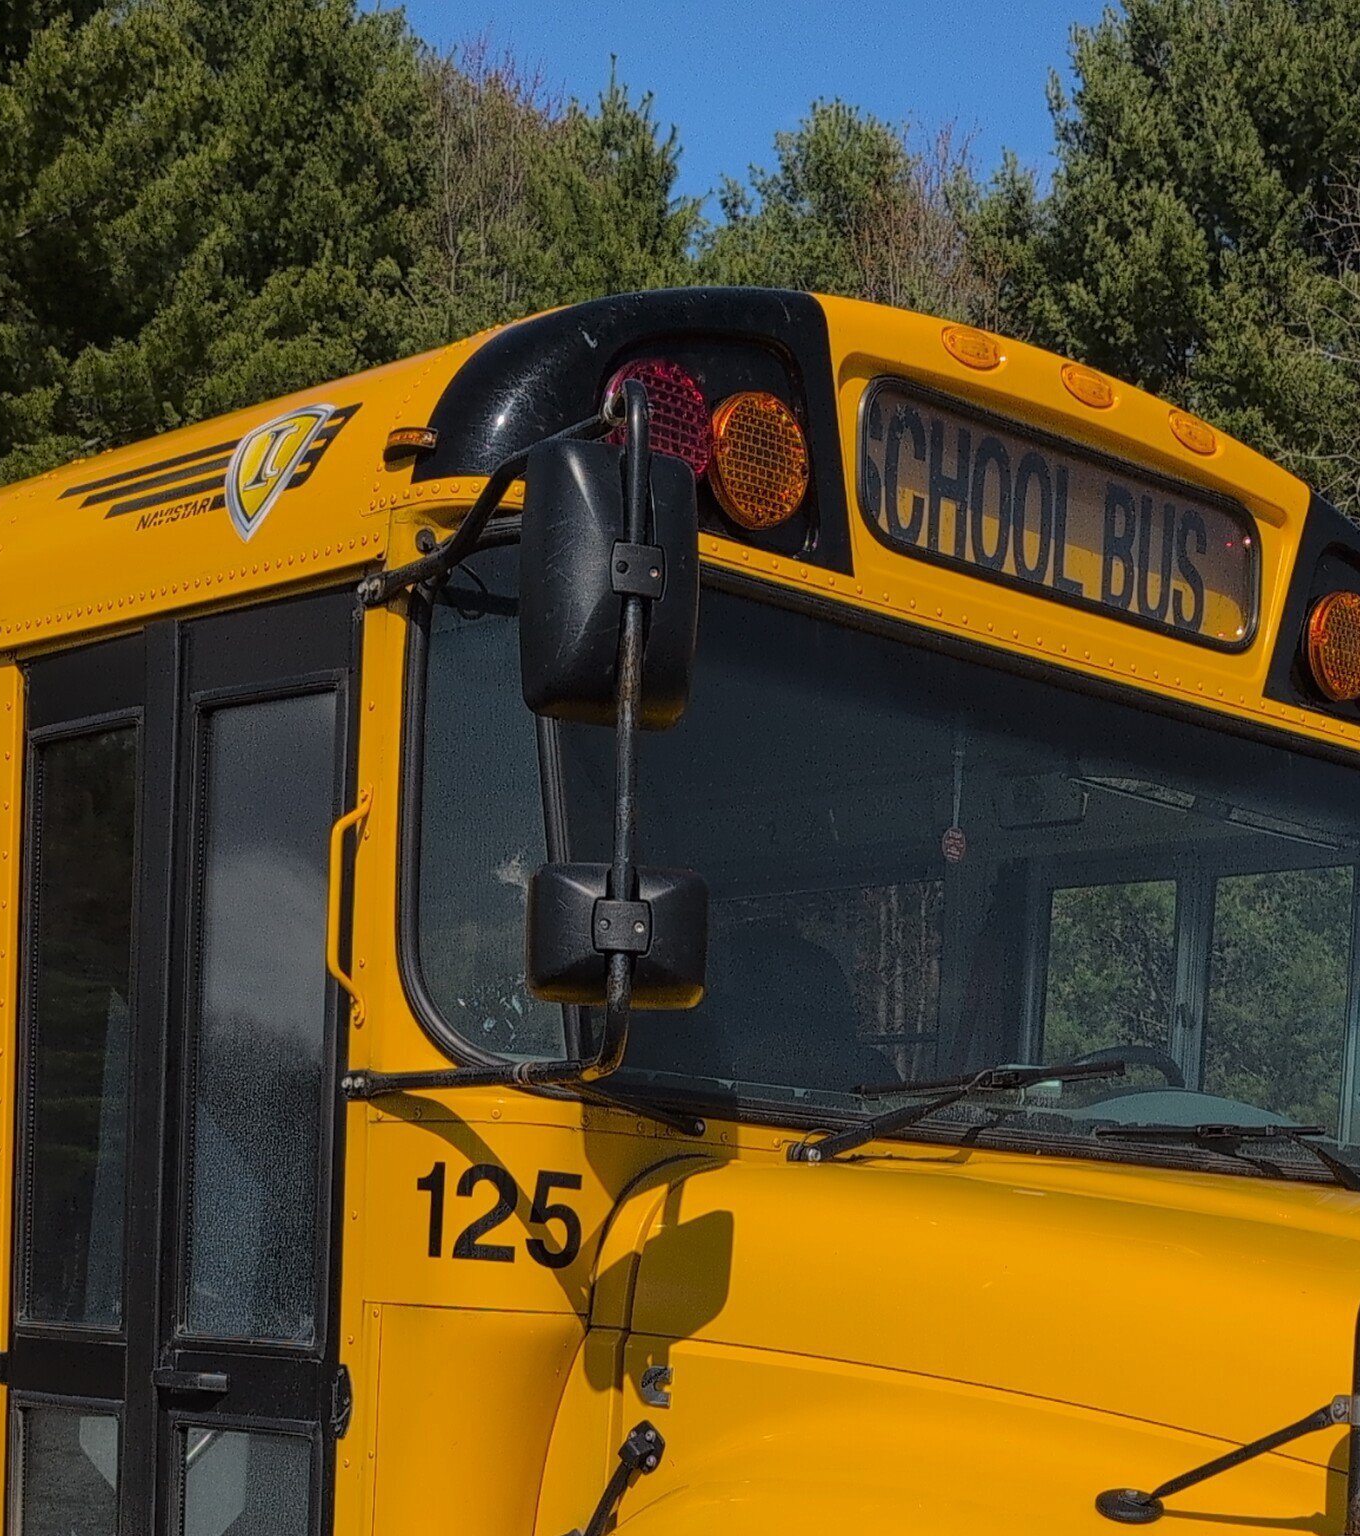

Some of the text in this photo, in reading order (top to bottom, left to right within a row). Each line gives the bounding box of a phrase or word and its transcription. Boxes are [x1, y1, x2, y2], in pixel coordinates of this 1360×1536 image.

[136, 496, 214, 531] NAVISTAR
[1101, 481, 1207, 635] BUS
[416, 1161, 583, 1269] 125
